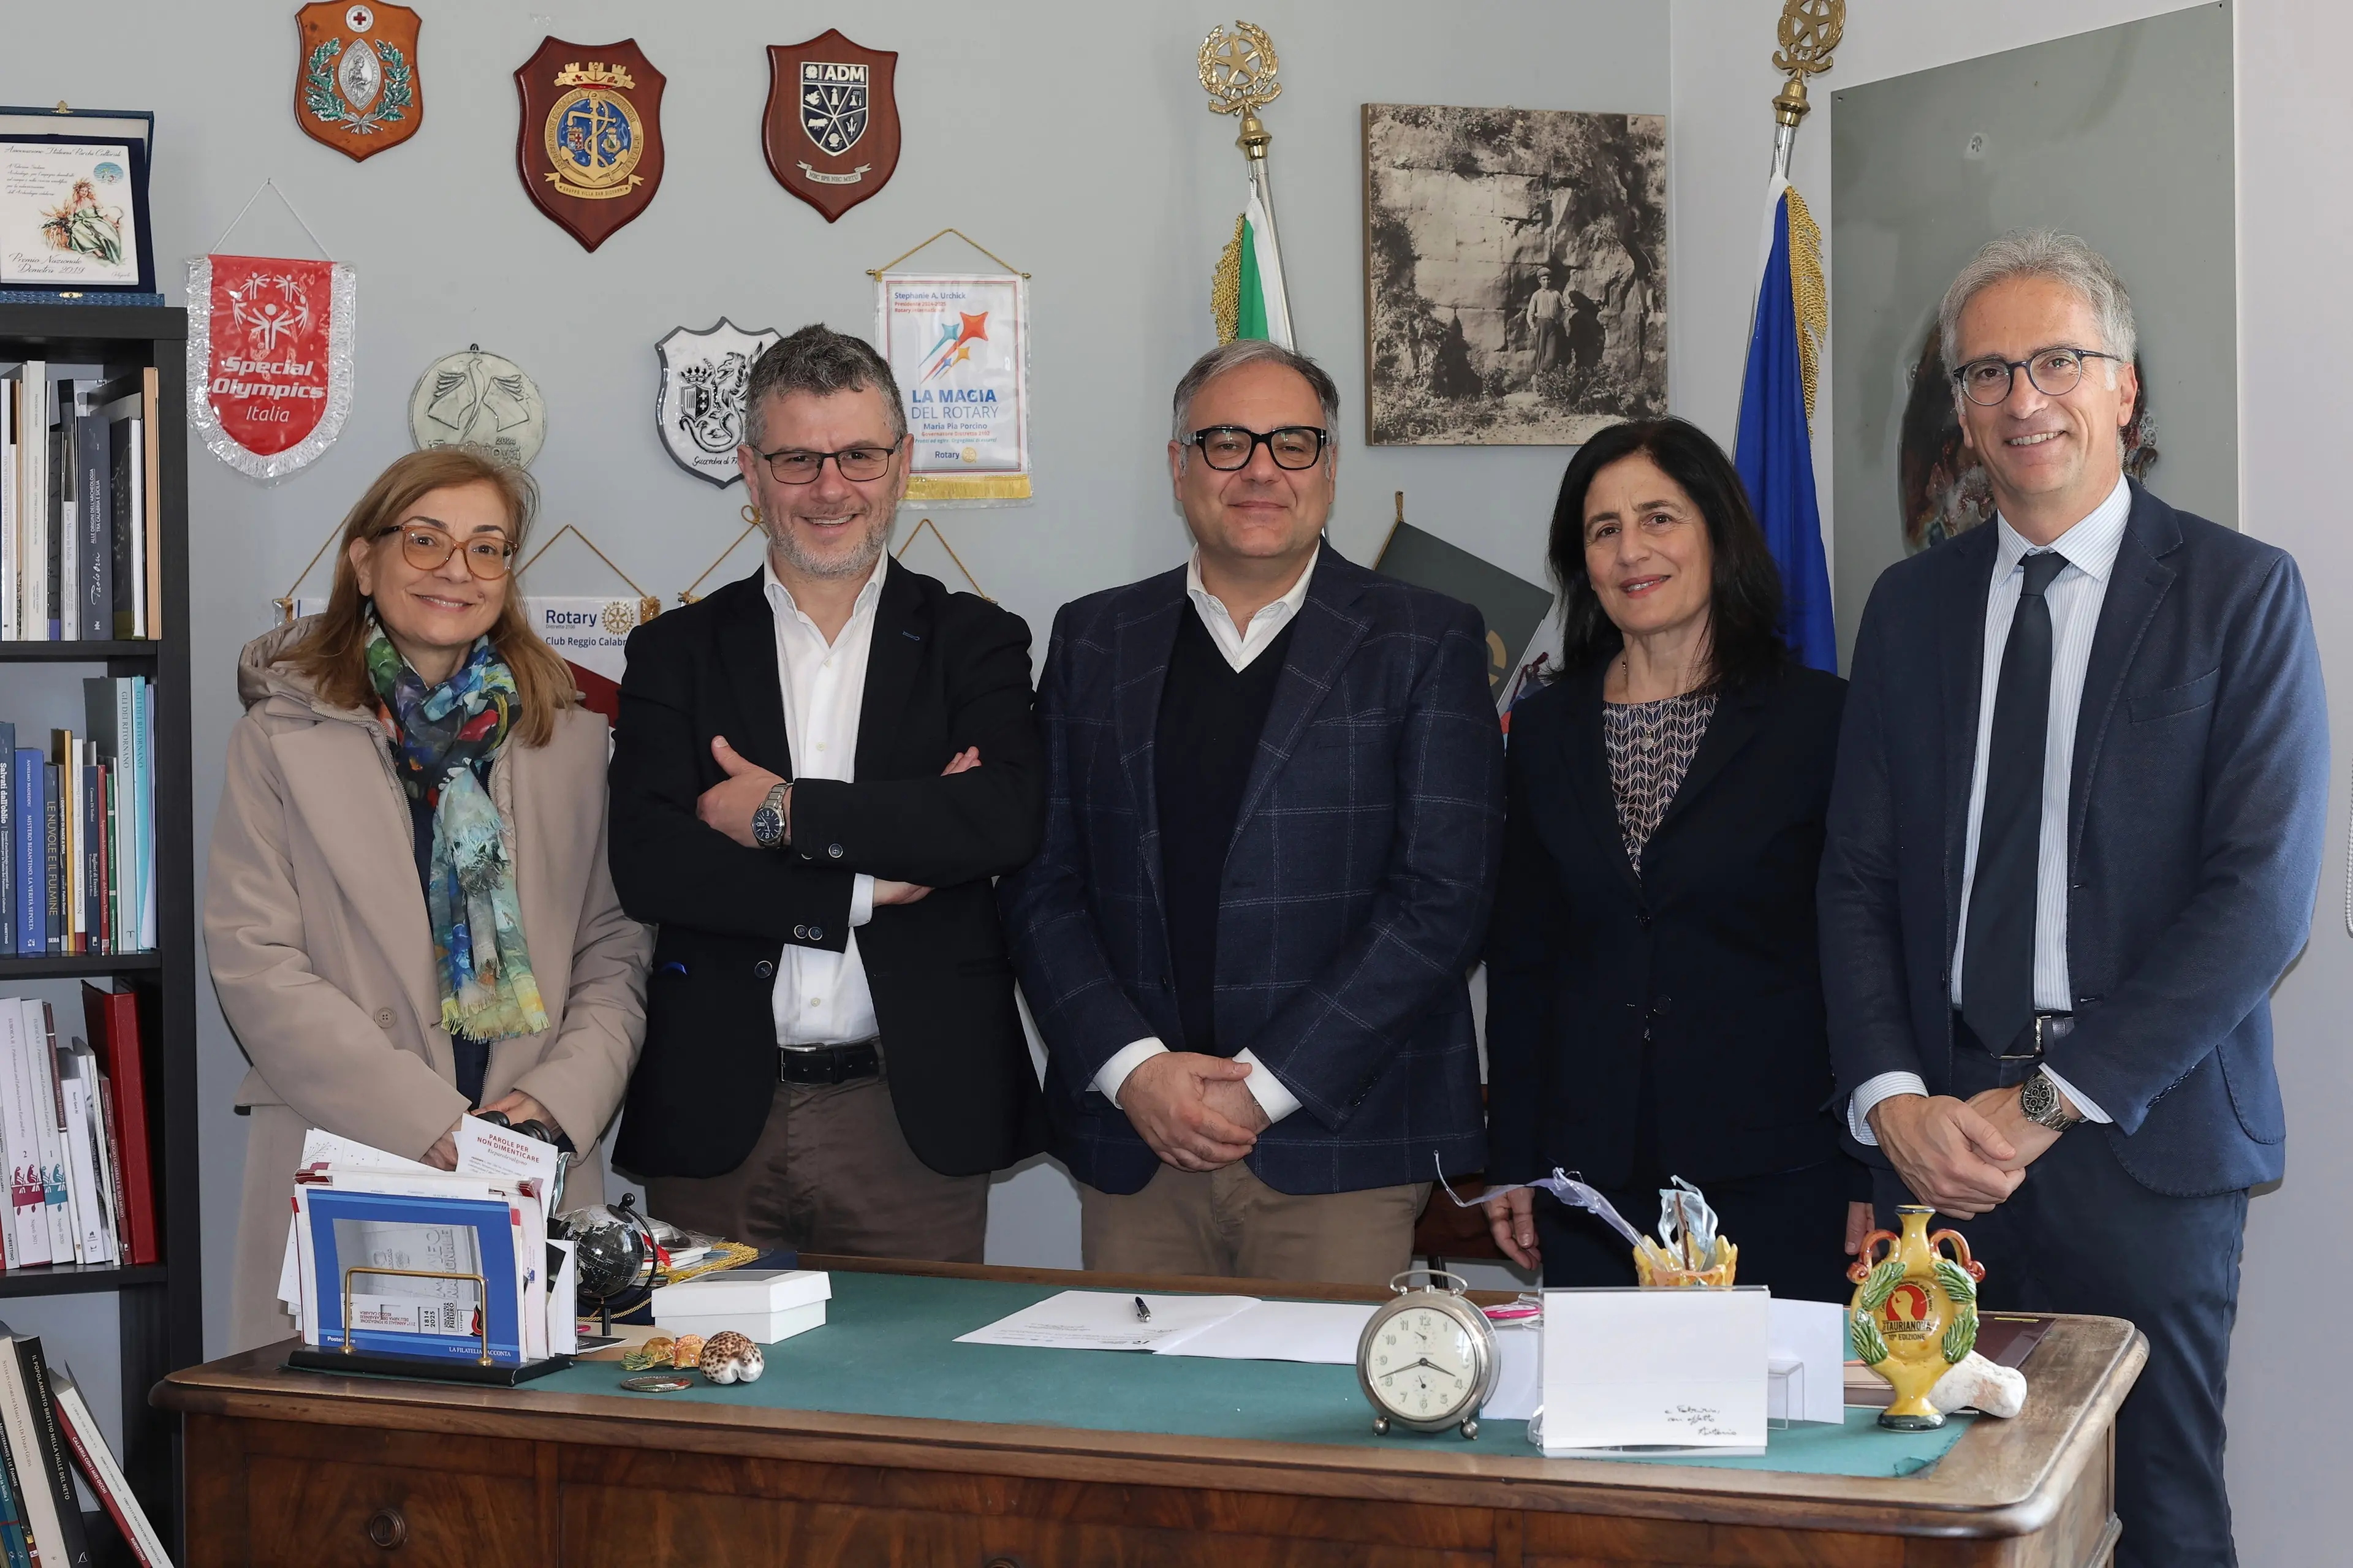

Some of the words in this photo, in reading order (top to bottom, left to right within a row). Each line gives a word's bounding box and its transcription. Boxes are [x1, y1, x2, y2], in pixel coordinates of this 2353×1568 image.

[824, 66, 865, 82] ADM
[9, 252, 40, 263] Premio
[40, 254, 82, 264] Nazionale
[18, 263, 54, 273] Demetra
[224, 357, 314, 376] Special
[211, 377, 324, 400] Olympics
[912, 389, 934, 403] LA
[939, 389, 998, 403] MAGIA
[246, 406, 290, 423] Italia
[912, 406, 938, 419] DEL
[944, 406, 999, 419] ROTARY
[495, 436, 516, 445] 2024
[934, 450, 960, 460] Rotary
[692, 456, 722, 467] Guardia
[91, 552, 100, 572] Orsi
[90, 574, 101, 605] Paolo
[545, 609, 597, 627] Rotary
[545, 637, 566, 646] Club
[567, 637, 596, 648] Reggio
[47, 801, 56, 811] LE
[47, 814, 57, 853] NUVOLE
[48, 874, 58, 916] FULMINE
[489, 1134, 515, 1148] PAROLE
[516, 1143, 529, 1153] PER
[477, 1137, 492, 1146] NON
[494, 1143, 540, 1163] DIMENTICARE
[1400, 1320, 1409, 1330] 11
[1419, 1316, 1431, 1326] 12
[1443, 1322, 1447, 1332] 1
[1385, 1335, 1396, 1345] 10
[457, 1347, 483, 1355] FILATELIA
[1380, 1355, 1387, 1365] 9
[1385, 1376, 1393, 1387] 8
[1454, 1379, 1463, 1389] 4
[1400, 1392, 1408, 1403] 7
[1440, 1393, 1448, 1404] 5
[1420, 1399, 1428, 1409] 6
[33, 1361, 48, 1407] POPOLAMENTO
[44, 1407, 55, 1433] BRETTIO
[50, 1433, 58, 1453] NELLA
[62, 1483, 70, 1500] NETO
[1698, 1426, 1737, 1436] Antonio
[72, 1436, 87, 1459] CALABRIA
[83, 1456, 93, 1468] CON
[91, 1469, 99, 1480] MIEI
[96, 1479, 108, 1494] OCCHI
[131, 1537, 146, 1561] RUBBETTINO
